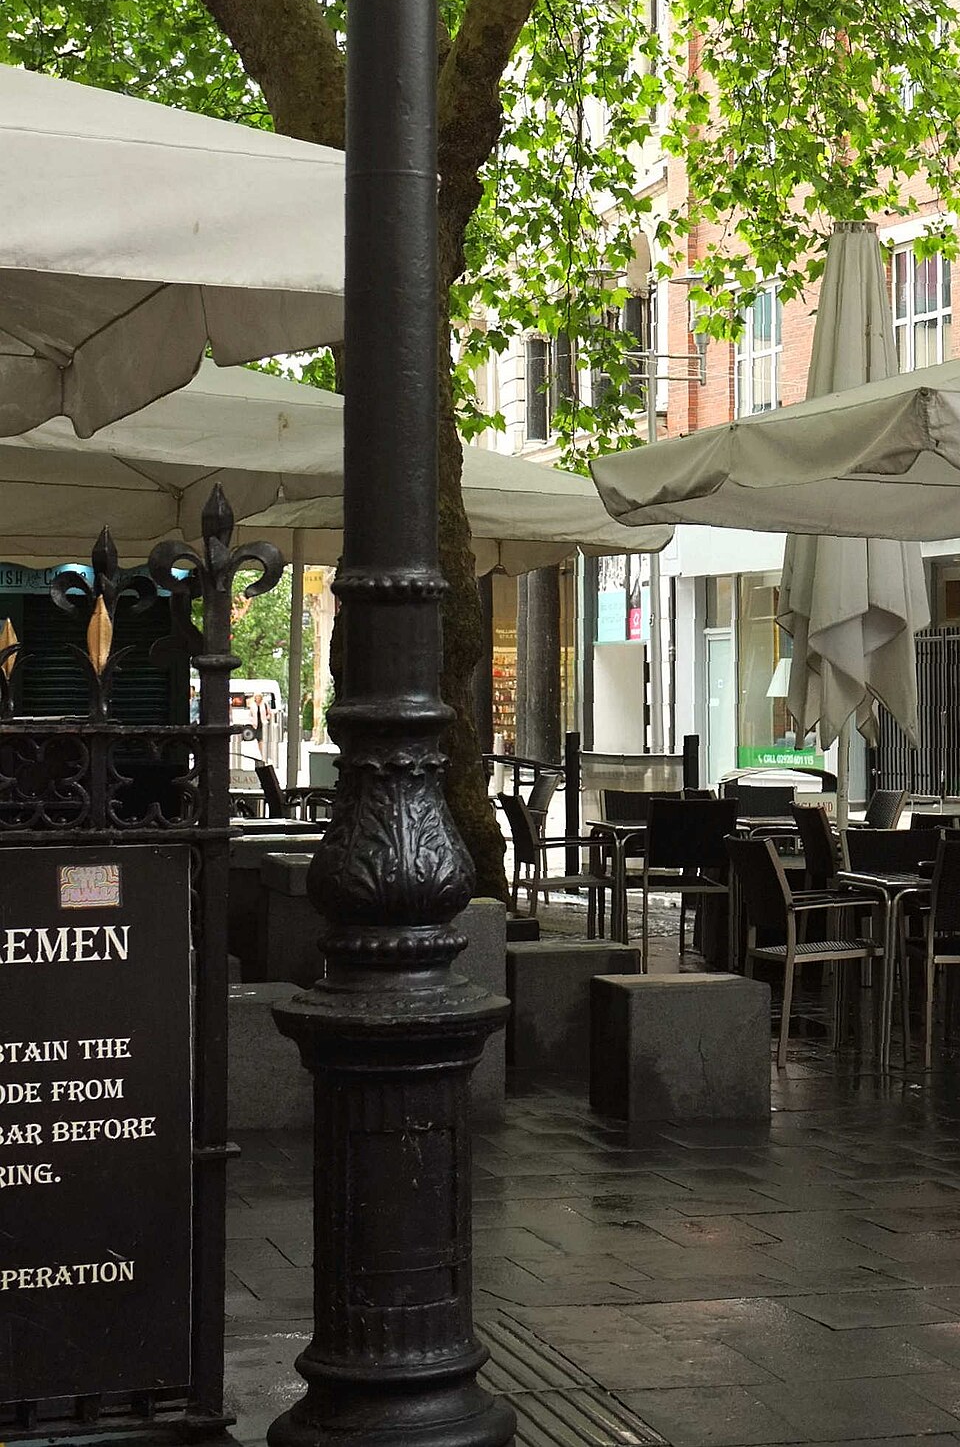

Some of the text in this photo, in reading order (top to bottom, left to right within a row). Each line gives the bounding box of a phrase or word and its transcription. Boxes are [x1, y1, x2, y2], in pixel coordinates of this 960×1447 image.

[763, 754, 776, 764] CALL
[0, 925, 131, 964] EMEN
[78, 1037, 132, 1060] THE
[50, 1078, 125, 1103] FROM
[0, 1116, 156, 1146] AR BEFORE
[0, 1260, 135, 1291] PERATION
